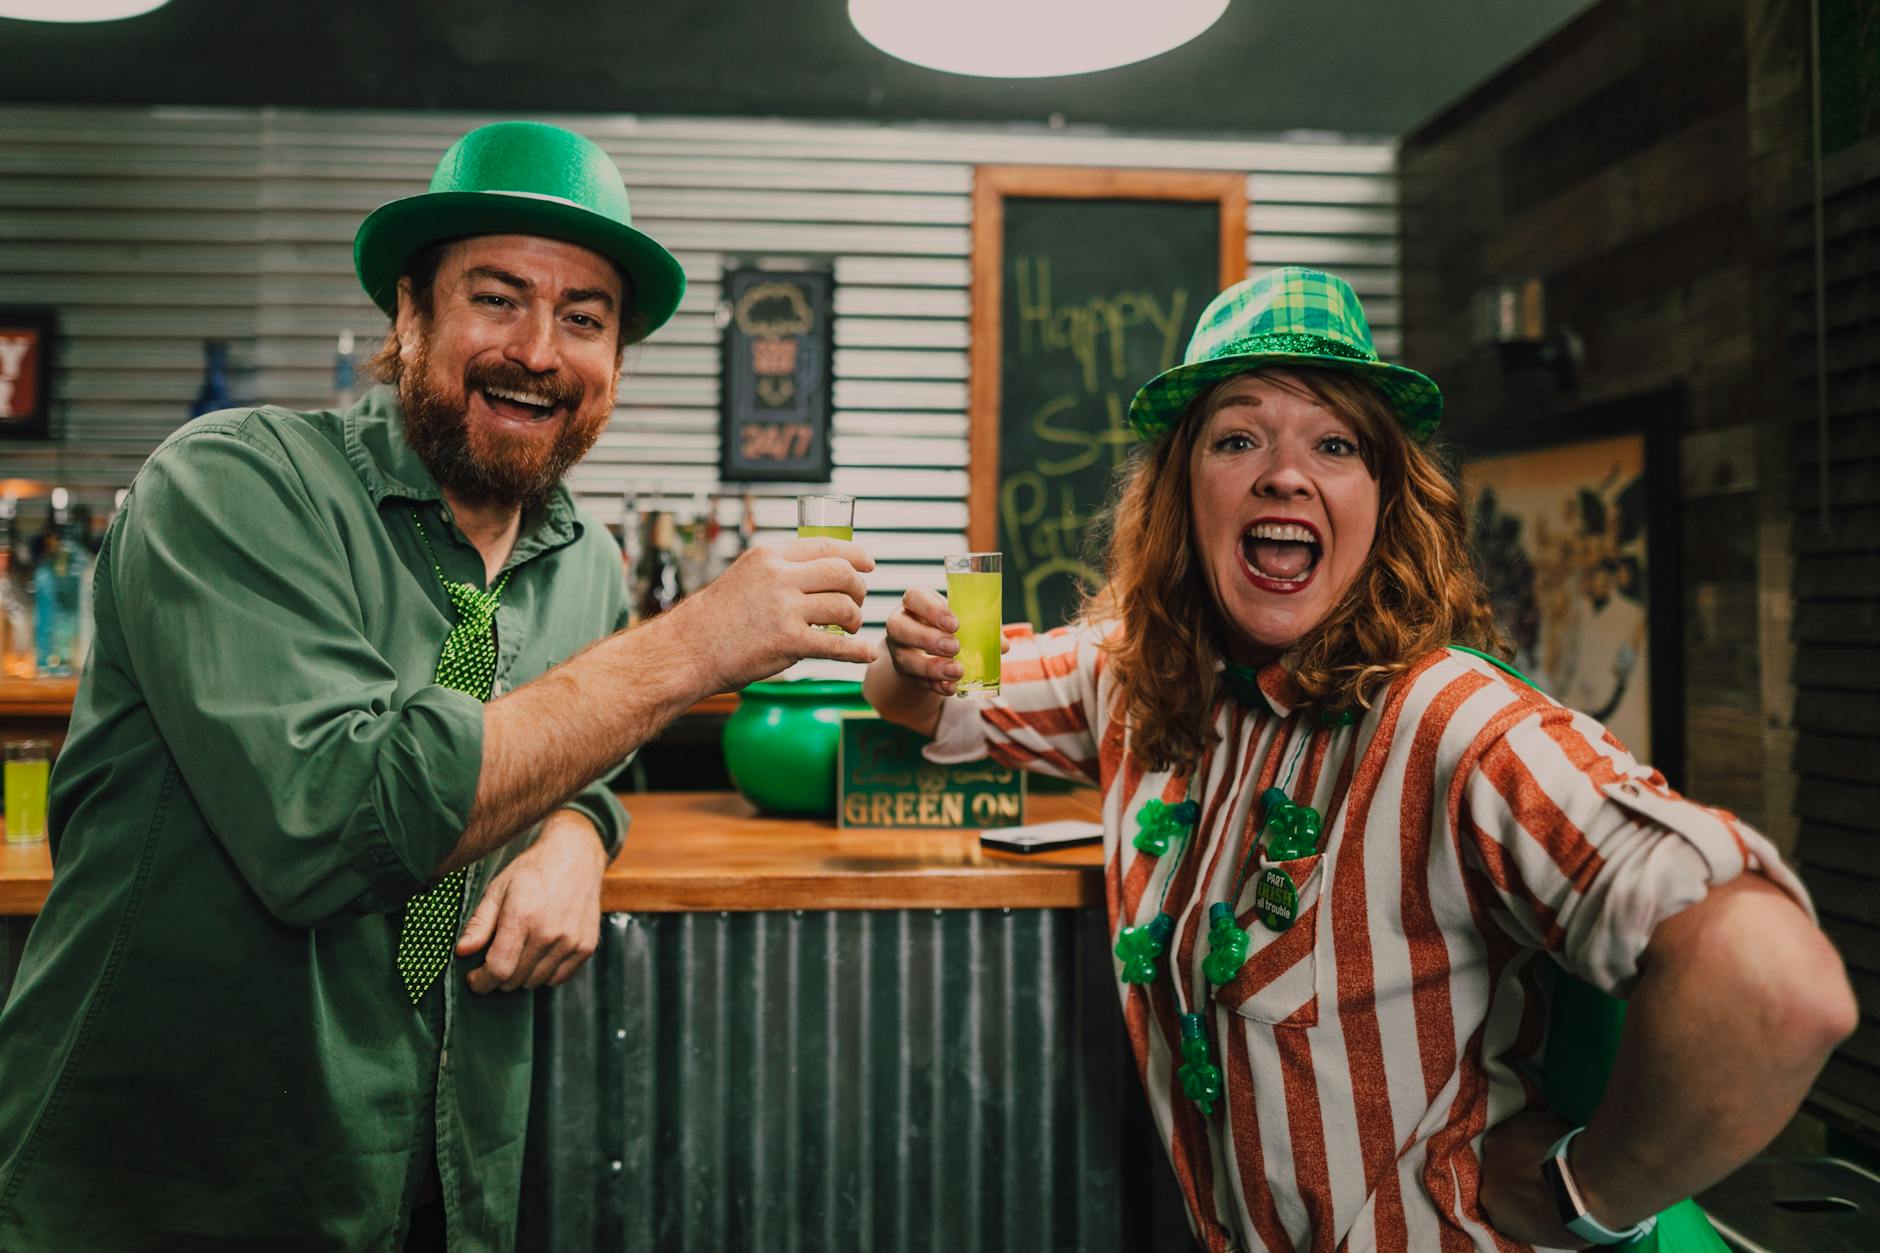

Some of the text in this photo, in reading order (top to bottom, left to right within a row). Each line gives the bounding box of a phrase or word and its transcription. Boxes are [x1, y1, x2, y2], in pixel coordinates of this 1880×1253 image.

[1015, 255, 1187, 392] Happy
[742, 423, 813, 460] 24/7
[844, 792, 1020, 826] GREEN ON
[1257, 881, 1293, 908] IRISH
[1266, 871, 1285, 888] PART
[1257, 896, 1291, 919] all trouble
